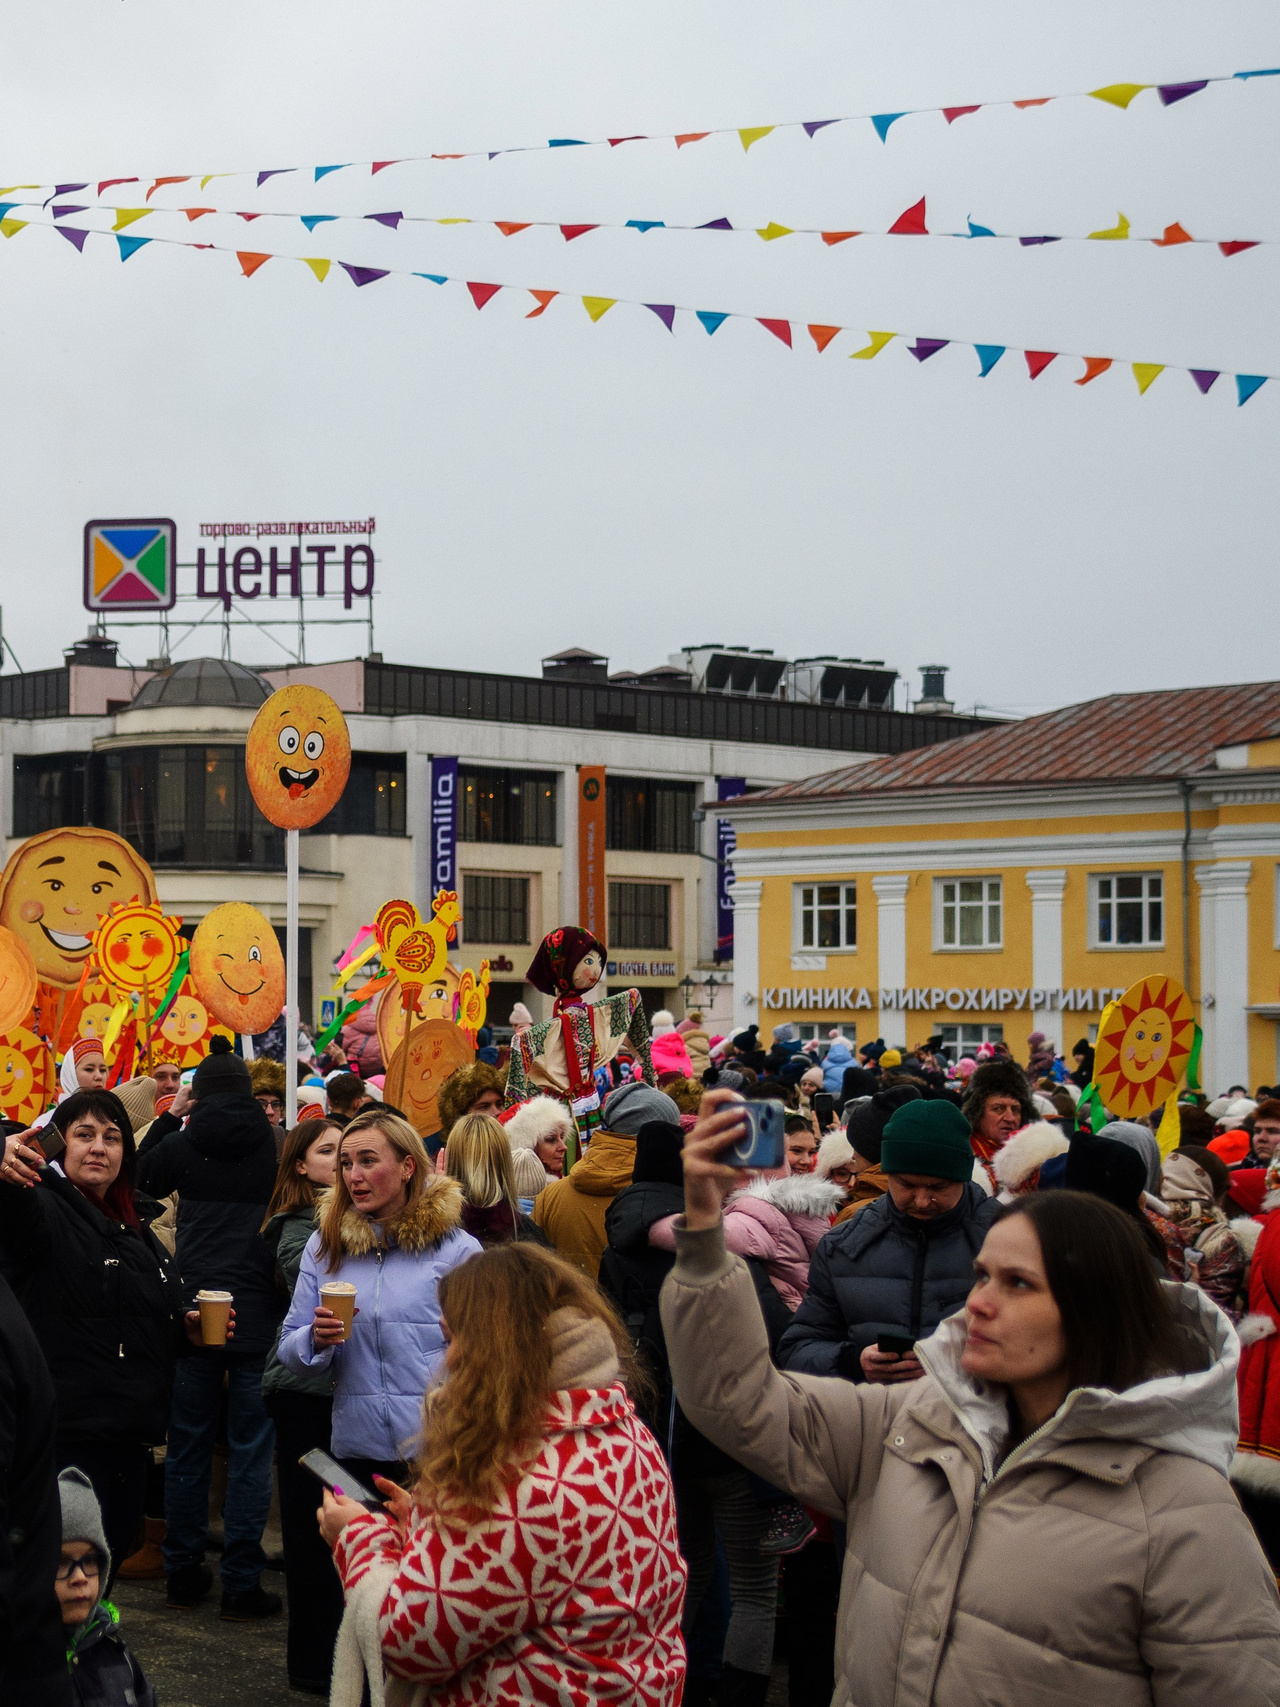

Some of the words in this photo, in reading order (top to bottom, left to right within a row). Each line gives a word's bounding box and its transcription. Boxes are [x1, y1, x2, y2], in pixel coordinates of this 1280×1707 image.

[200, 517, 376, 540] торгово-развлекательный
[196, 544, 375, 611] центр
[432, 772, 454, 898] familia
[619, 962, 650, 976] ПОЧТА
[652, 962, 676, 976] БАНК
[762, 987, 872, 1010] КЛИНИКА
[878, 988, 1094, 1011] МИКРОХИРУРГИИ
